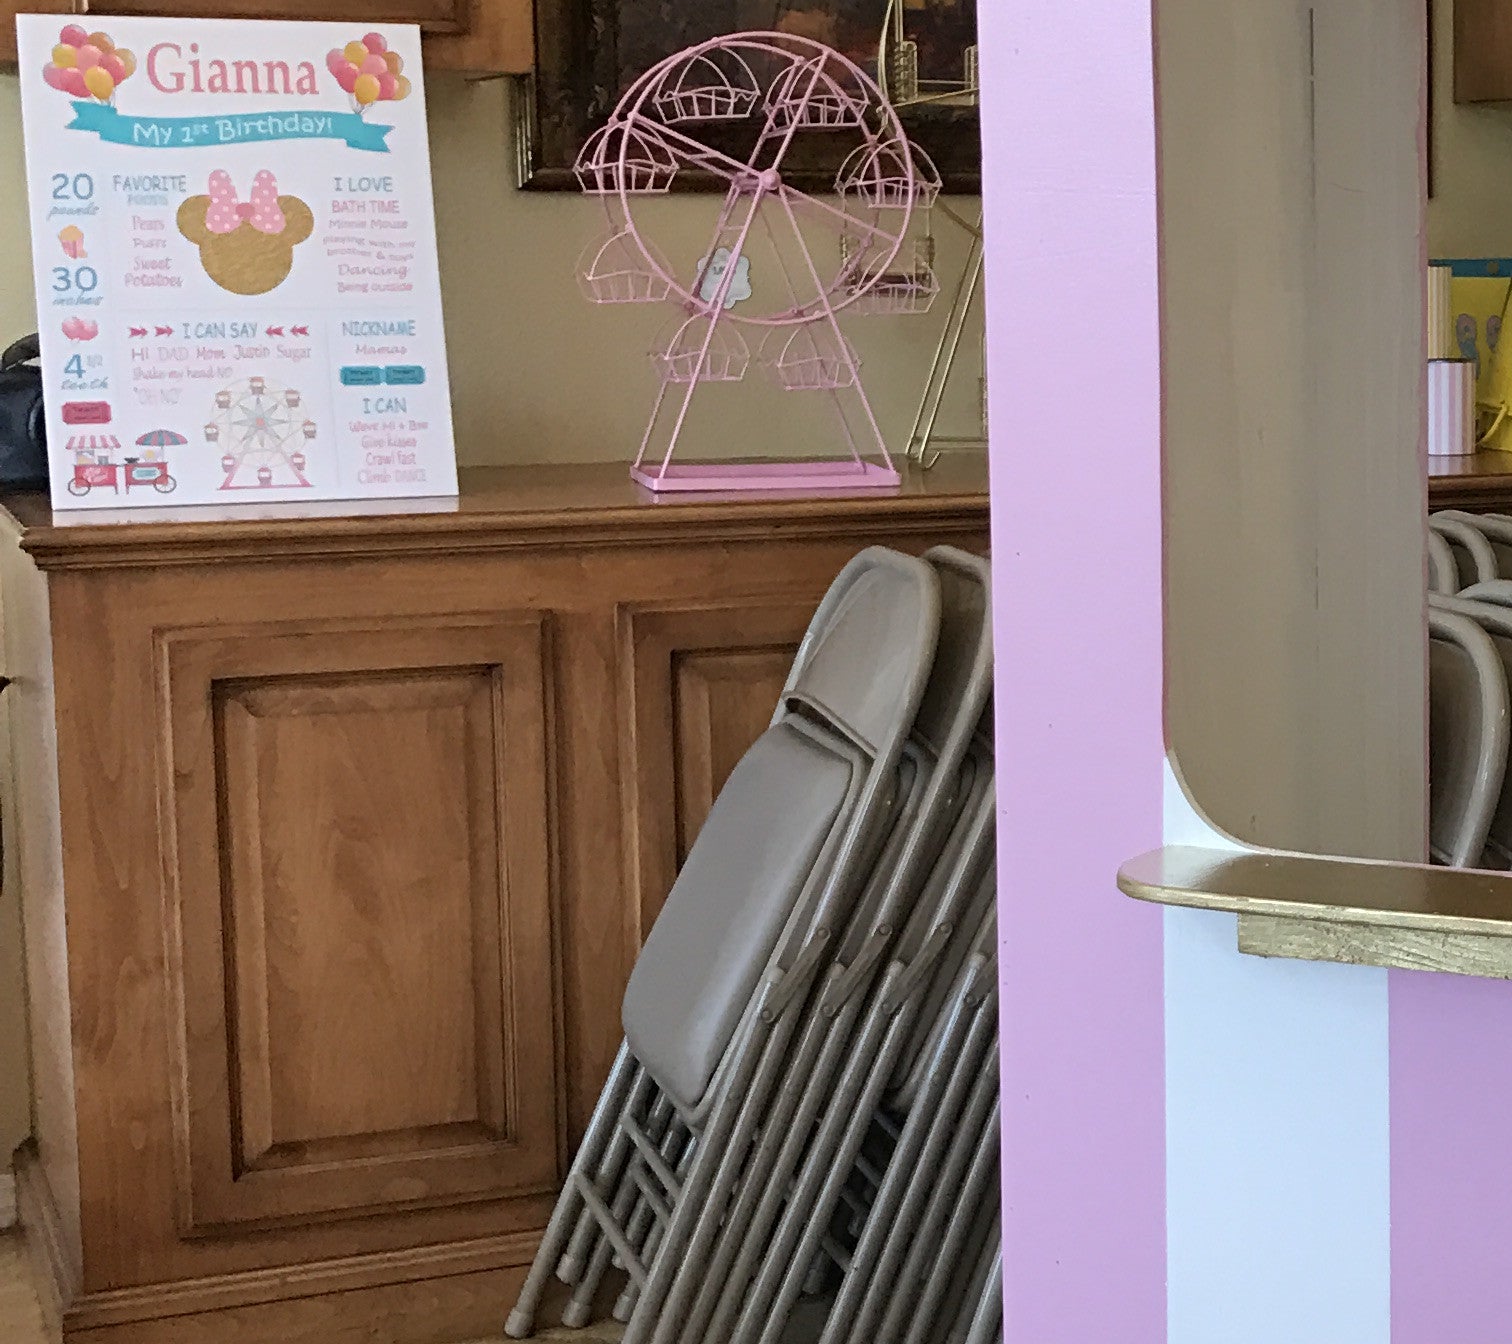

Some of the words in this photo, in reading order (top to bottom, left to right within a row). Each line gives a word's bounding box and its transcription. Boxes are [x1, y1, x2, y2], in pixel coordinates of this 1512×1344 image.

[147, 42, 319, 95] Gianna
[133, 123, 173, 145] My
[182, 122, 208, 143] 1st
[215, 114, 332, 141] Birthday!
[52, 173, 94, 200] 20
[113, 175, 187, 193] FAVORITE
[334, 177, 342, 192] I
[348, 176, 394, 192] LOVE
[332, 200, 366, 213] BATH
[369, 200, 400, 213] TIME
[52, 266, 97, 292] 30
[338, 264, 408, 279] Dancing
[183, 322, 191, 339] I
[195, 322, 225, 338] CAN
[230, 322, 258, 339] SAY
[342, 320, 416, 336] NICKNAME
[64, 354, 86, 379] 4
[363, 398, 370, 414] I
[374, 397, 407, 414] CAN
